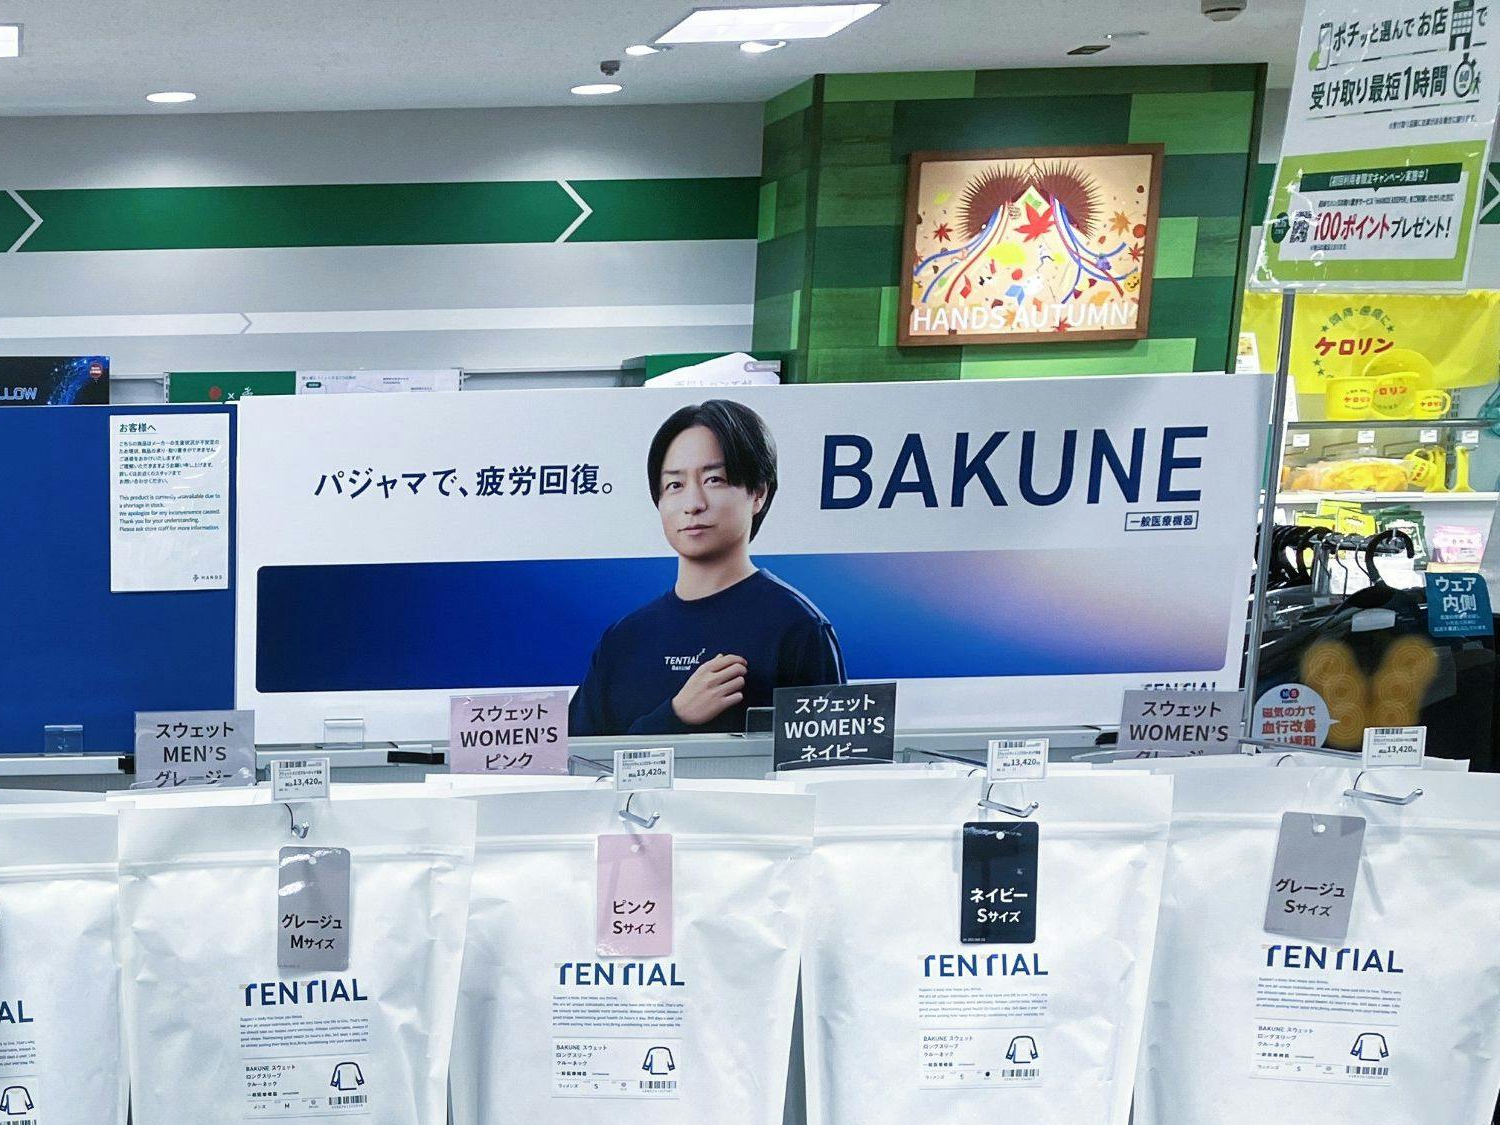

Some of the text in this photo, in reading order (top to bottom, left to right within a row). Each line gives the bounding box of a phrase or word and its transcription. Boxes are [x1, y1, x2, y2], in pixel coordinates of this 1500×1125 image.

[1310, 65, 1451, 110] 受け取り最短1時間
[914, 303, 1130, 331] HANDS AUTUMN
[1315, 336, 1394, 356] ケロリン
[120, 423, 156, 433] お客様へ
[820, 426, 1208, 510] BAKUNE
[314, 464, 612, 499] パジャマで、疲労回復。
[1129, 514, 1193, 527] 一般医療機器
[1435, 577, 1477, 592] ウェア
[1443, 595, 1477, 613] 内側
[665, 655, 700, 664] TENTIAL
[470, 703, 549, 722] スウェット
[795, 694, 876, 714] スウェット
[1142, 701, 1221, 718] スウェット
[1262, 706, 1316, 718] 磁気の力で
[155, 721, 234, 739] スウェット
[1261, 720, 1316, 734] 血行改善
[485, 753, 534, 769] ピンク
[800, 744, 869, 762] ネイビー
[969, 888, 1028, 904] ネイビー
[1275, 878, 1346, 899] グレージュ
[612, 900, 657, 916] ピンク
[977, 908, 1020, 924] Sサイズ
[1284, 899, 1333, 918] Sサイズ
[281, 913, 343, 930] グレージュ
[612, 920, 656, 935] Sサイズ
[290, 934, 335, 951] Mサイズ
[918, 953, 1048, 978] TENTIAL
[1261, 944, 1404, 974] TENTIAL
[555, 962, 685, 987] TENTIAL
[239, 978, 368, 1007] TENTIAL
